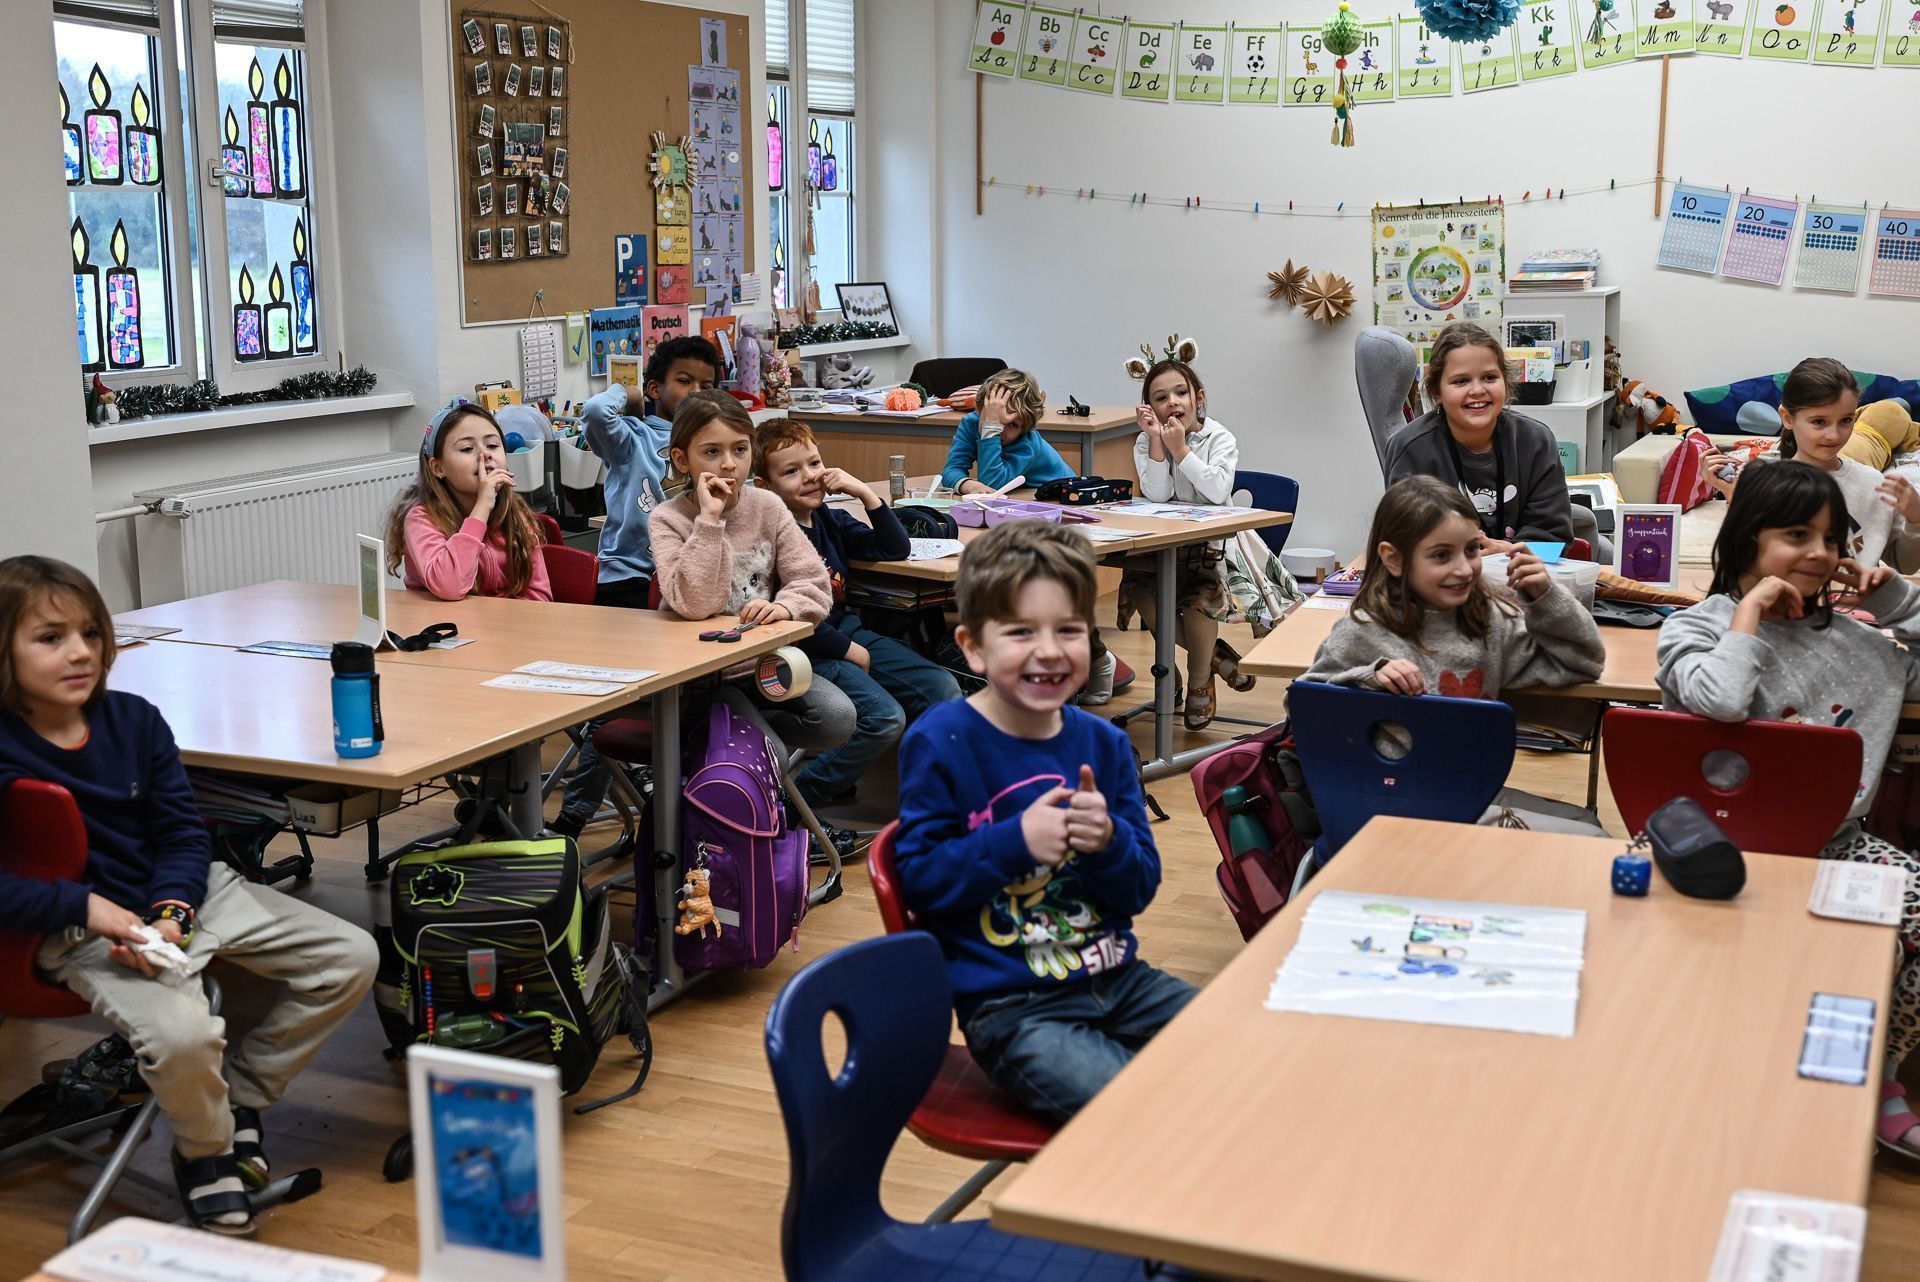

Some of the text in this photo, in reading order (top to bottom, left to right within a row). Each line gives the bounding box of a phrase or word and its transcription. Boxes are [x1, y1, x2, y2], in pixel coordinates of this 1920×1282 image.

[991, 8, 1011, 25] Aa
[1532, 6, 1555, 24] Kk
[1040, 16, 1060, 33] Bb
[1088, 26, 1110, 42] Cc
[1140, 32, 1160, 48] Dd
[1194, 34, 1212, 50] Ee
[1664, 29, 1680, 42] m
[1762, 29, 1780, 48] O
[1247, 36, 1266, 51] Ff
[1302, 34, 1322, 53] Gg
[976, 48, 1008, 66] A a
[1078, 65, 1091, 82] C
[1128, 72, 1160, 90] D d
[1294, 77, 1326, 102] G g
[1681, 196, 1697, 210] 10
[1378, 206, 1499, 222] Kennst du die Jahreszeiten?
[1744, 206, 1765, 221] 20
[1812, 216, 1834, 230] 30
[1886, 222, 1908, 236] 40
[616, 237, 633, 272] P
[591, 314, 640, 332] Mathematik
[652, 315, 682, 330] Deutsch
